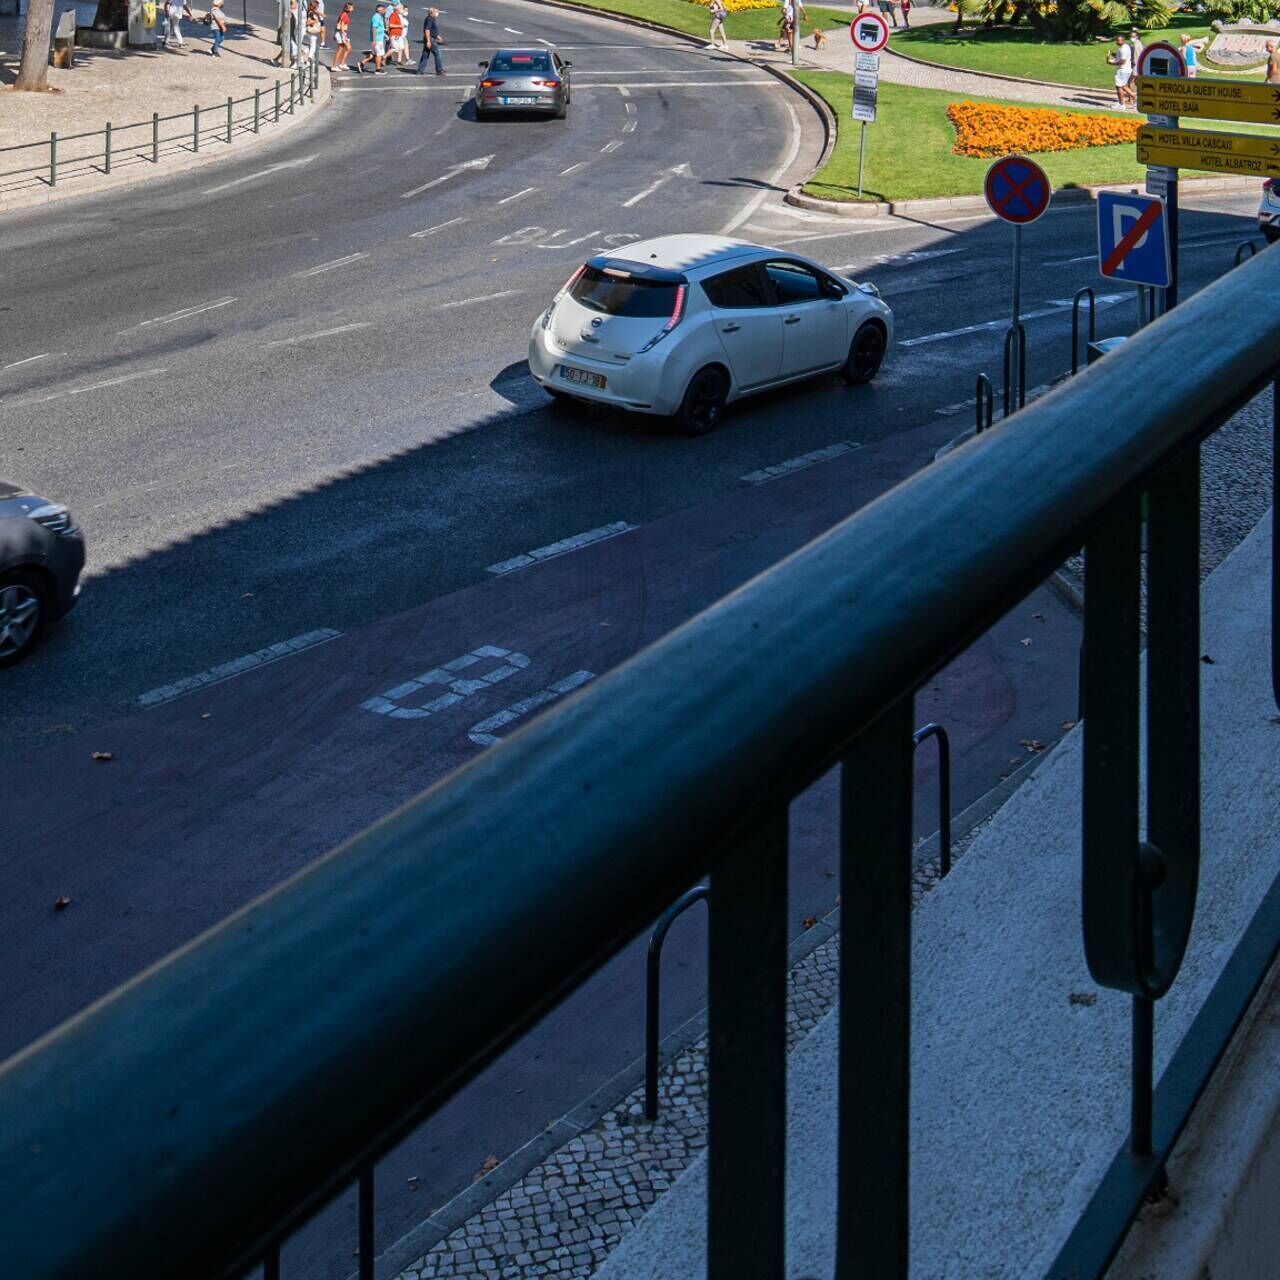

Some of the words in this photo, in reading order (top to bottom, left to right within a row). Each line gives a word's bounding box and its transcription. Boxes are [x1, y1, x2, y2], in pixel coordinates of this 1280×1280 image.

[1158, 82, 1193, 95] PERGOLA
[1193, 85, 1218, 97] GUEST
[1218, 88, 1242, 99] HOUSE
[1158, 100, 1182, 113] HOTEL
[1158, 133, 1182, 146] HOTEL
[1183, 136, 1201, 147] VILLA
[1202, 138, 1233, 151] CASCAIS
[1201, 155, 1223, 168] HOTEL
[1225, 157, 1263, 172] ALBATROZ
